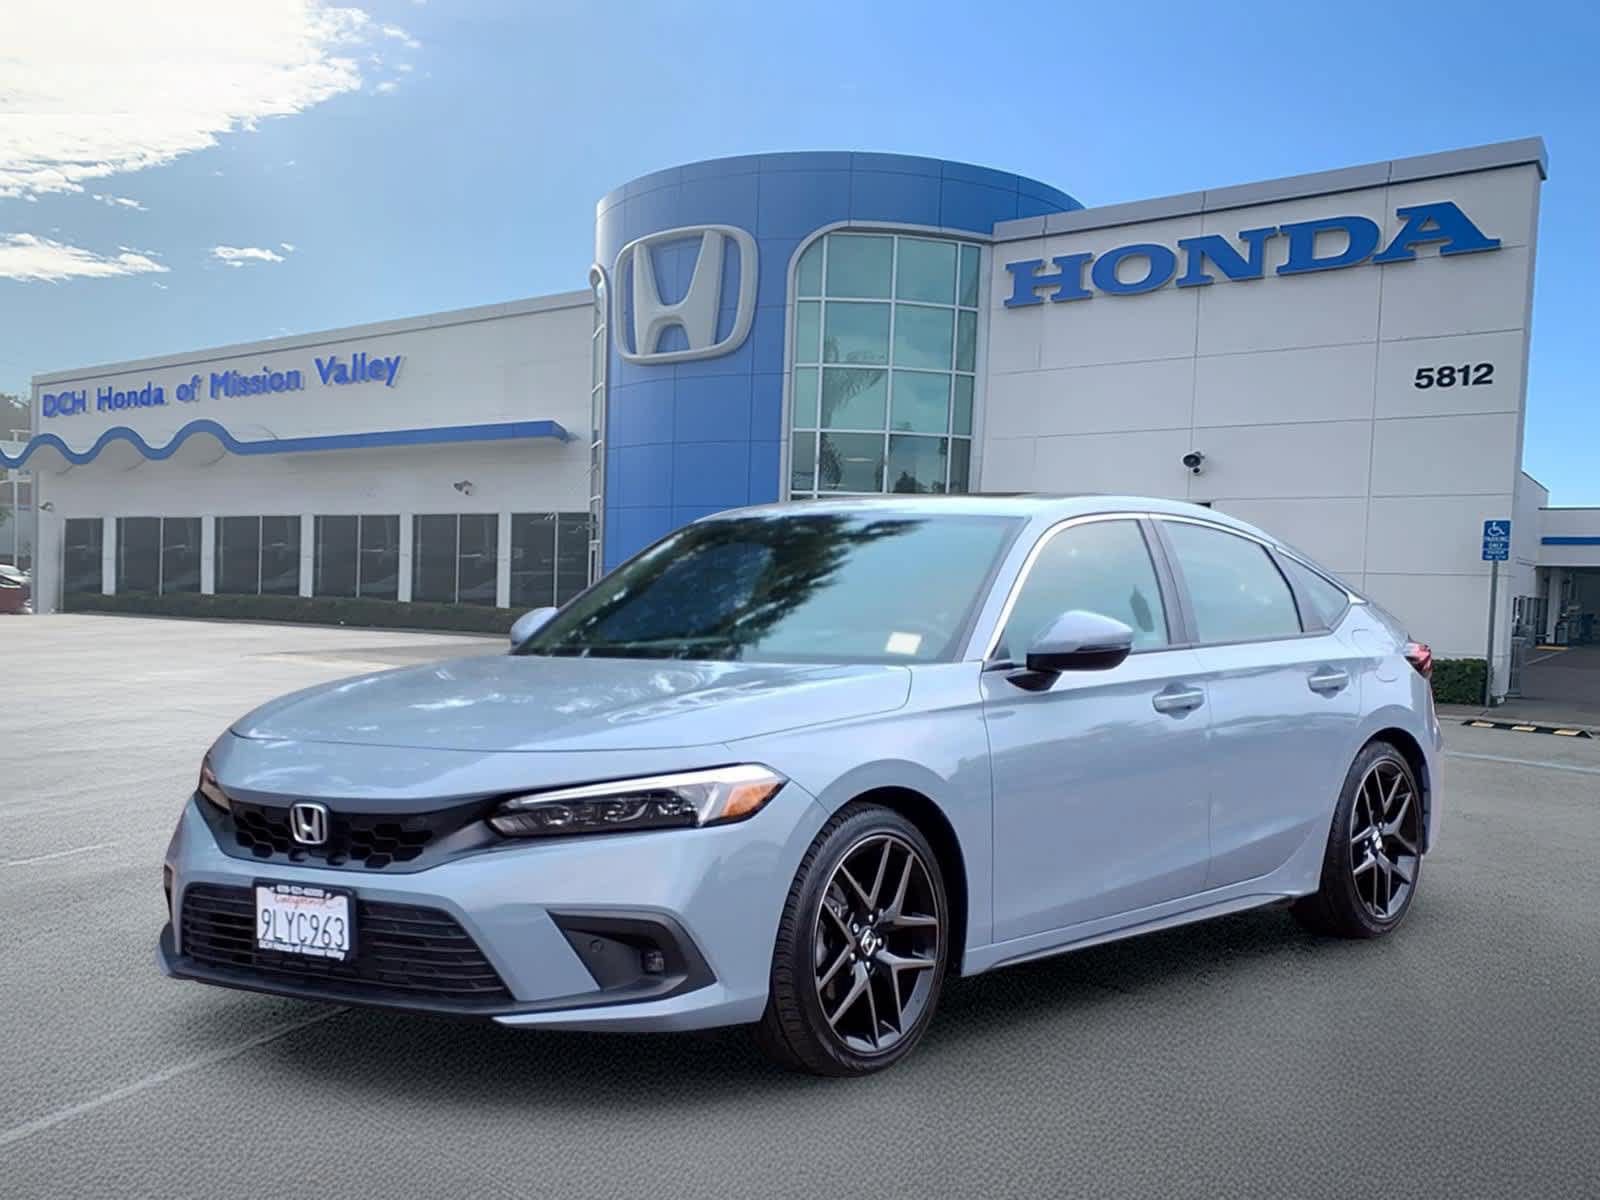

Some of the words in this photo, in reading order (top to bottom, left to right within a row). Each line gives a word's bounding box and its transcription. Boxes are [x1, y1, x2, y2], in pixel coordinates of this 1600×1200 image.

[1004, 201, 1501, 309] HONDA
[42, 390, 87, 418] DCH
[97, 381, 165, 411] Honda
[176, 375, 202, 402] of
[210, 367, 303, 399] Mission
[315, 352, 402, 388] Valley
[1414, 363, 1494, 389] 5812
[261, 908, 345, 948] 9LYC963
